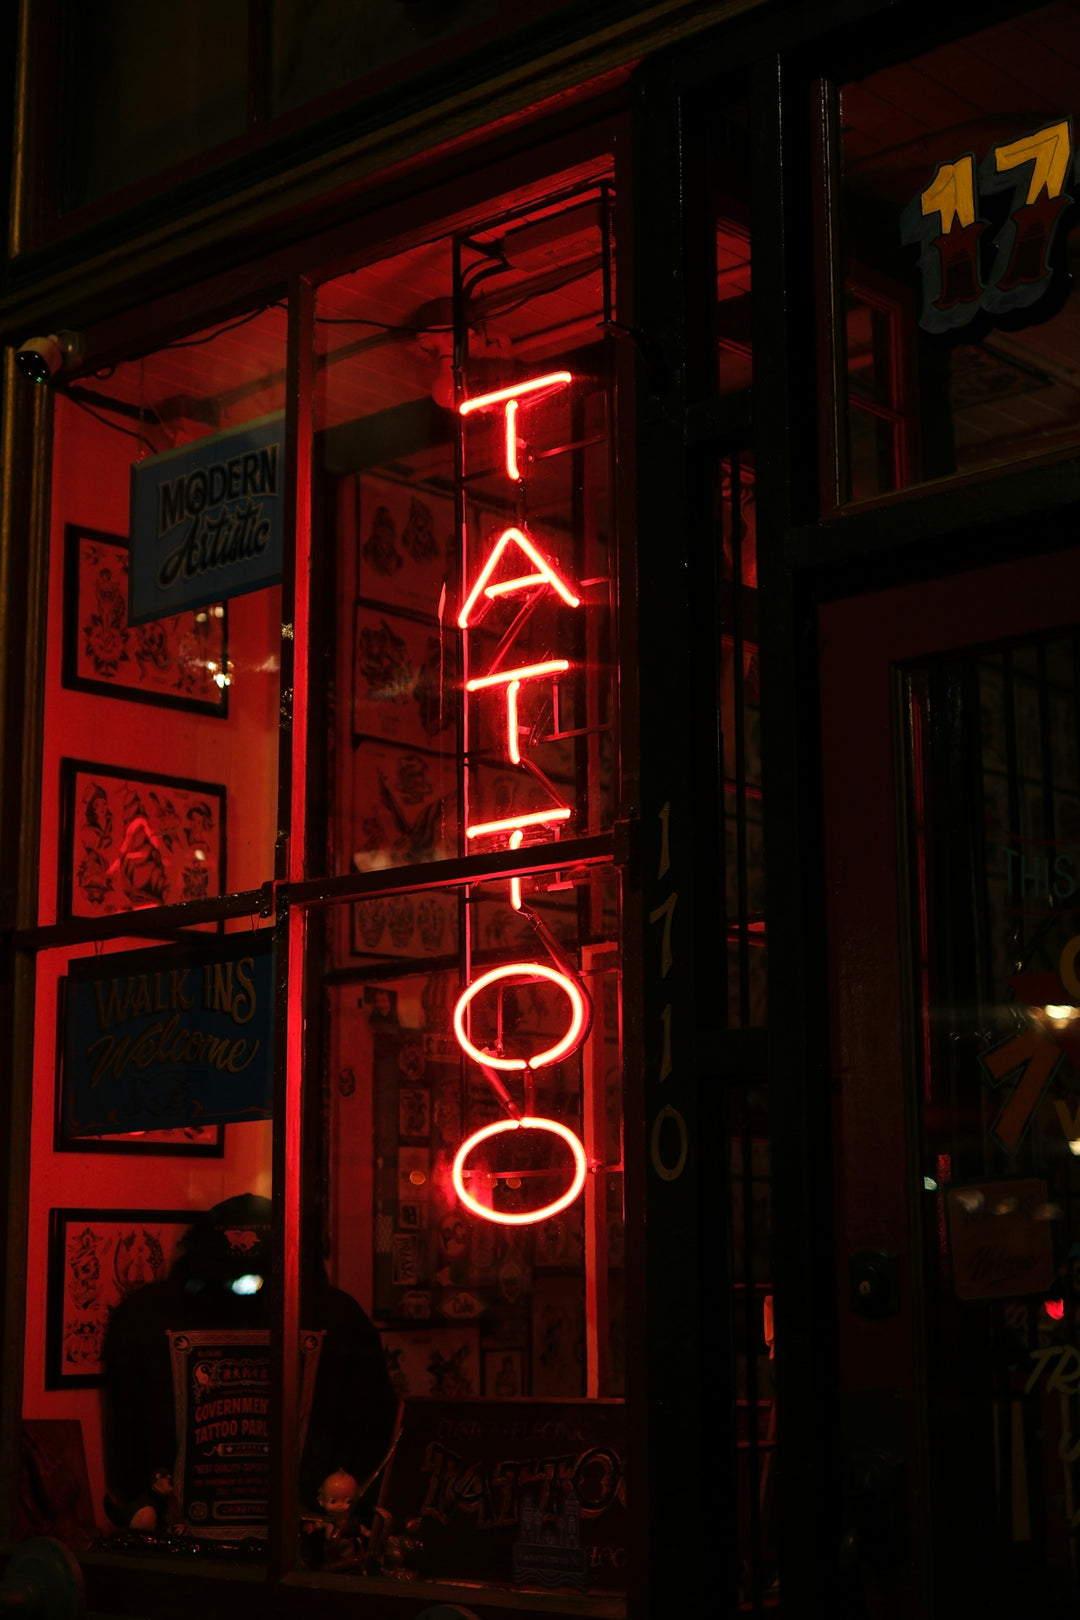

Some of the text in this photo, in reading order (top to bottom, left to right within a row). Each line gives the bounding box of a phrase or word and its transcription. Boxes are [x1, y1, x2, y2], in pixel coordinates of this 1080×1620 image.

[912, 119, 1073, 325] 17
[158, 443, 279, 538] MODERN
[156, 501, 272, 588] Artistic
[454, 371, 587, 1226] TATTOO
[998, 847, 1075, 900] THIS
[92, 957, 257, 1032] WALK INS
[648, 801, 689, 1182] 1710
[87, 1012, 261, 1090] Welcome
[194, 1396, 270, 1423] GOVERNMEN
[194, 1418, 238, 1446] TATTOO
